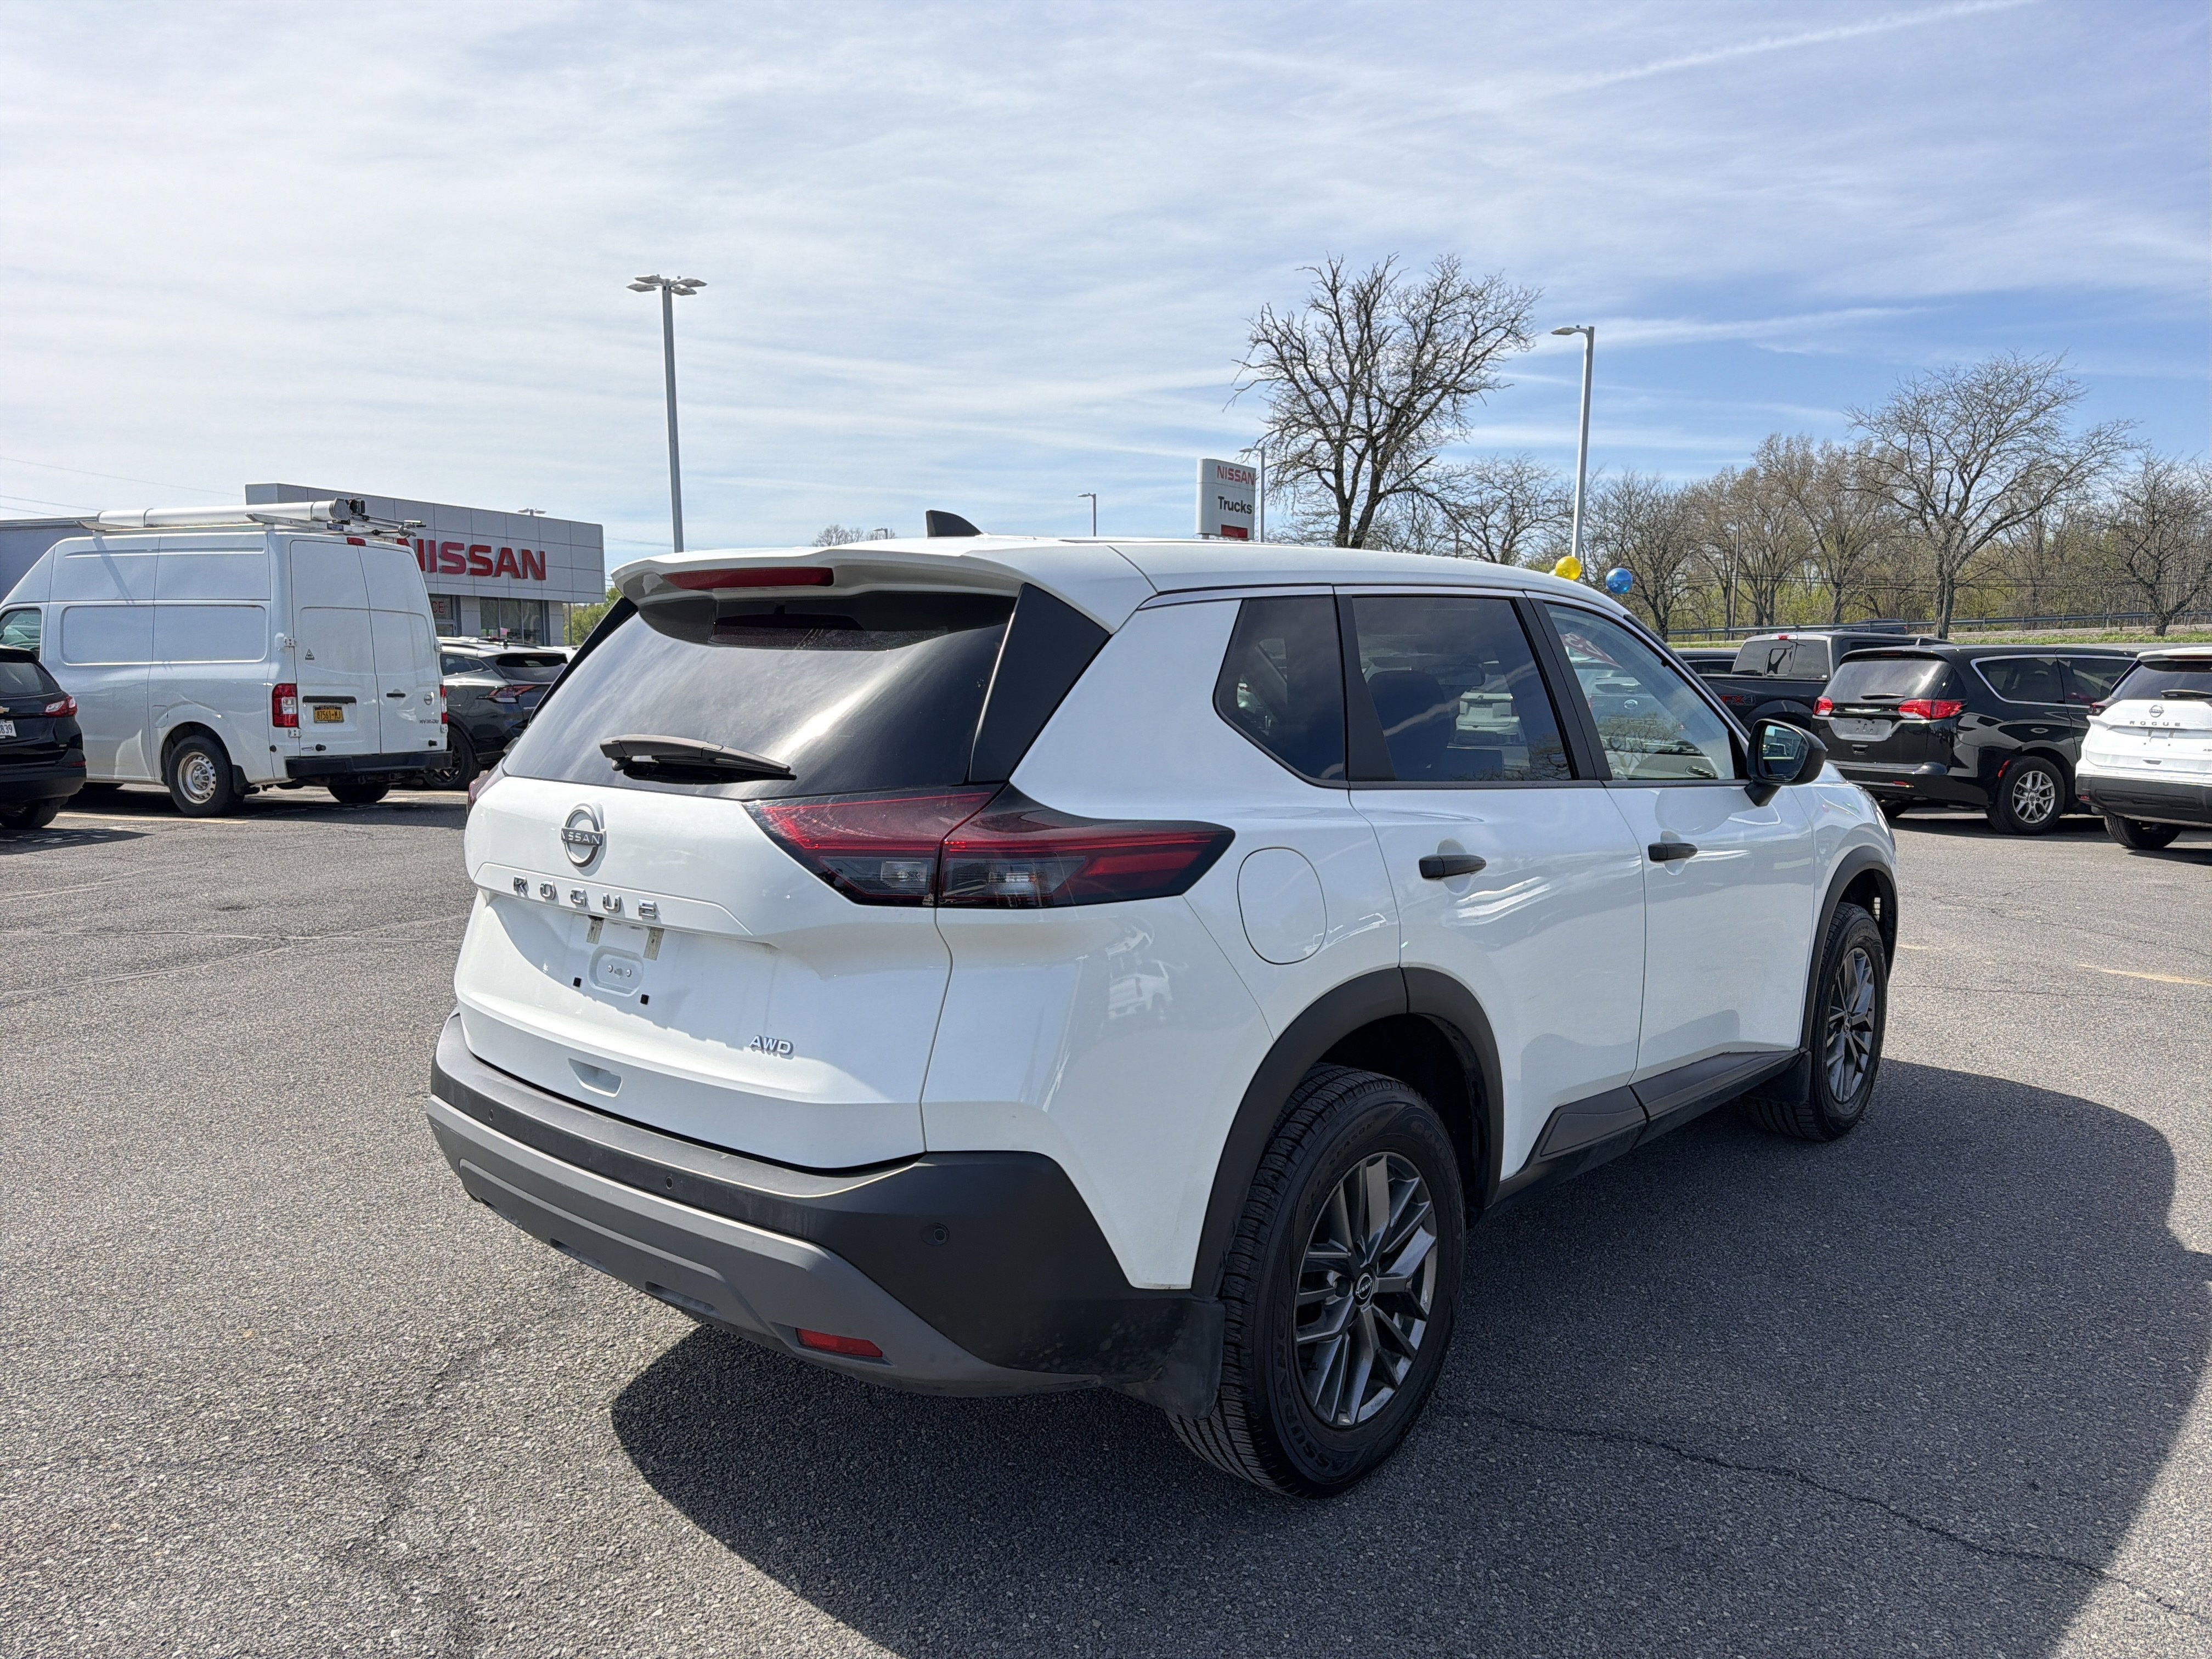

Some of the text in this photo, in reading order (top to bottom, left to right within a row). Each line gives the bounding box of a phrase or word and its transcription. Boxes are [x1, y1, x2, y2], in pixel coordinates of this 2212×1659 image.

[1217, 465, 1255, 486] NISSAN
[1218, 496, 1252, 515] Trucks
[0, 724, 13, 734] 839
[561, 830, 600, 845] SSAN
[513, 874, 657, 920] ROGUE
[749, 1035, 793, 1056] AWD
